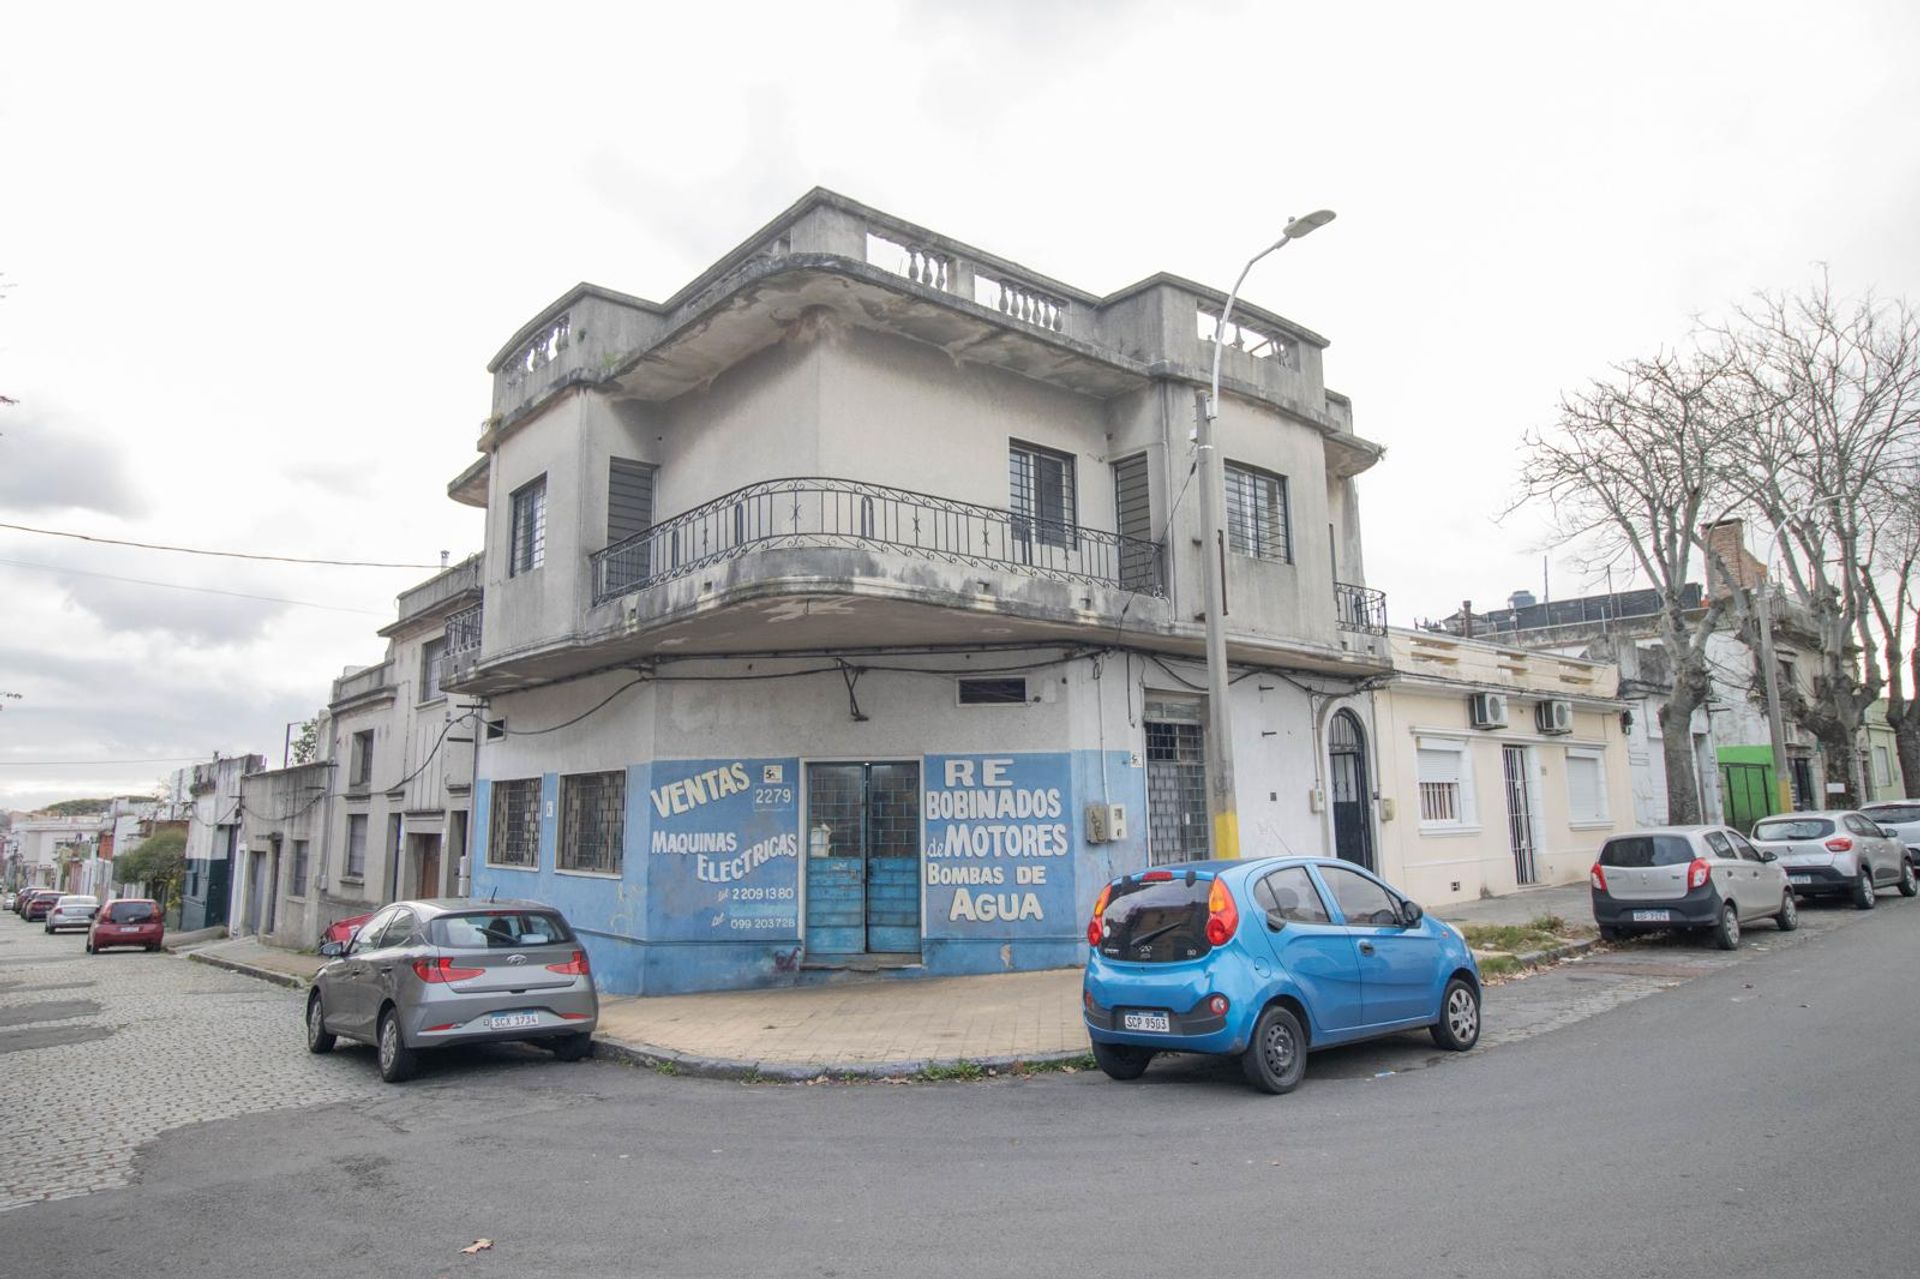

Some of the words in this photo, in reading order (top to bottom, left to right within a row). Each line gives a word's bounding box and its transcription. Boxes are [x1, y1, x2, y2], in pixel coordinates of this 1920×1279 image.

[650, 762, 751, 819] VENTAS
[755, 788, 792, 804] 2279
[926, 788, 1063, 820] BOBINADOS
[652, 830, 738, 854] MAQUINAS
[927, 837, 944, 857] de
[944, 823, 1068, 858] MOTORES
[697, 833, 798, 883] ELECTRICAS
[926, 862, 1004, 885] BOMBAS
[1016, 865, 1047, 885] DE
[949, 888, 1044, 922] AGUA
[1126, 1016, 1142, 1028] SCP
